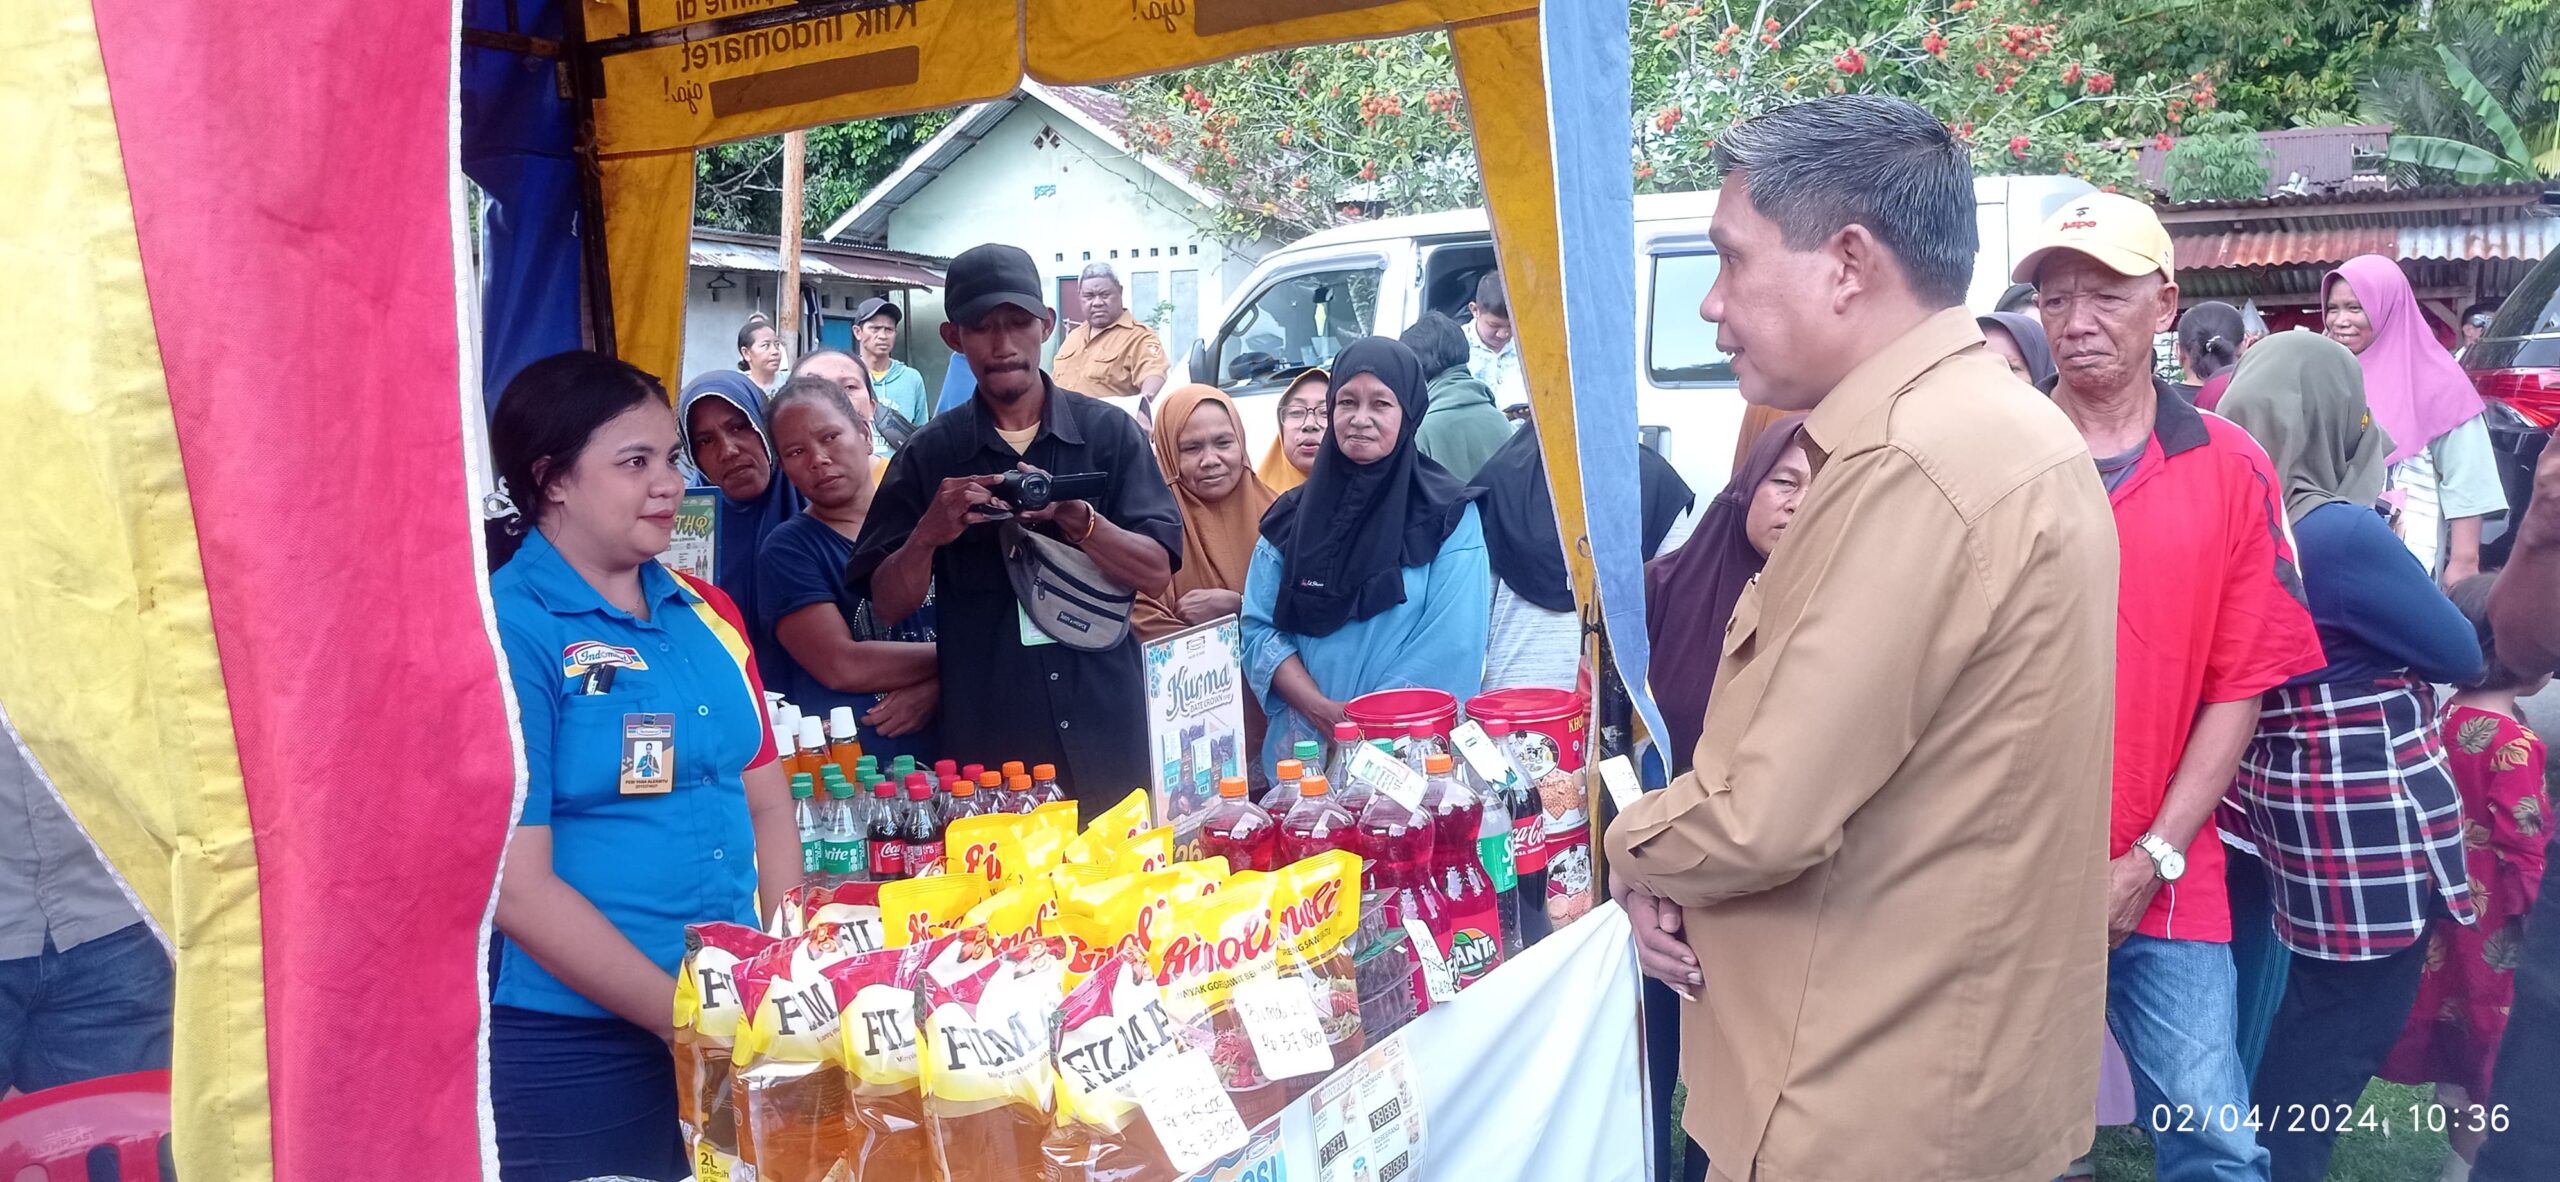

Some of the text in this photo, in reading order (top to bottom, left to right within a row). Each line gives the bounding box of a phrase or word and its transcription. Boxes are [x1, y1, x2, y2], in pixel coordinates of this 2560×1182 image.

[1167, 664, 1232, 717] Kurma
[824, 847, 849, 861] rite
[1446, 935, 1497, 988] FANTA
[862, 1008, 916, 1056] FIL
[701, 1152, 717, 1169] 2L
